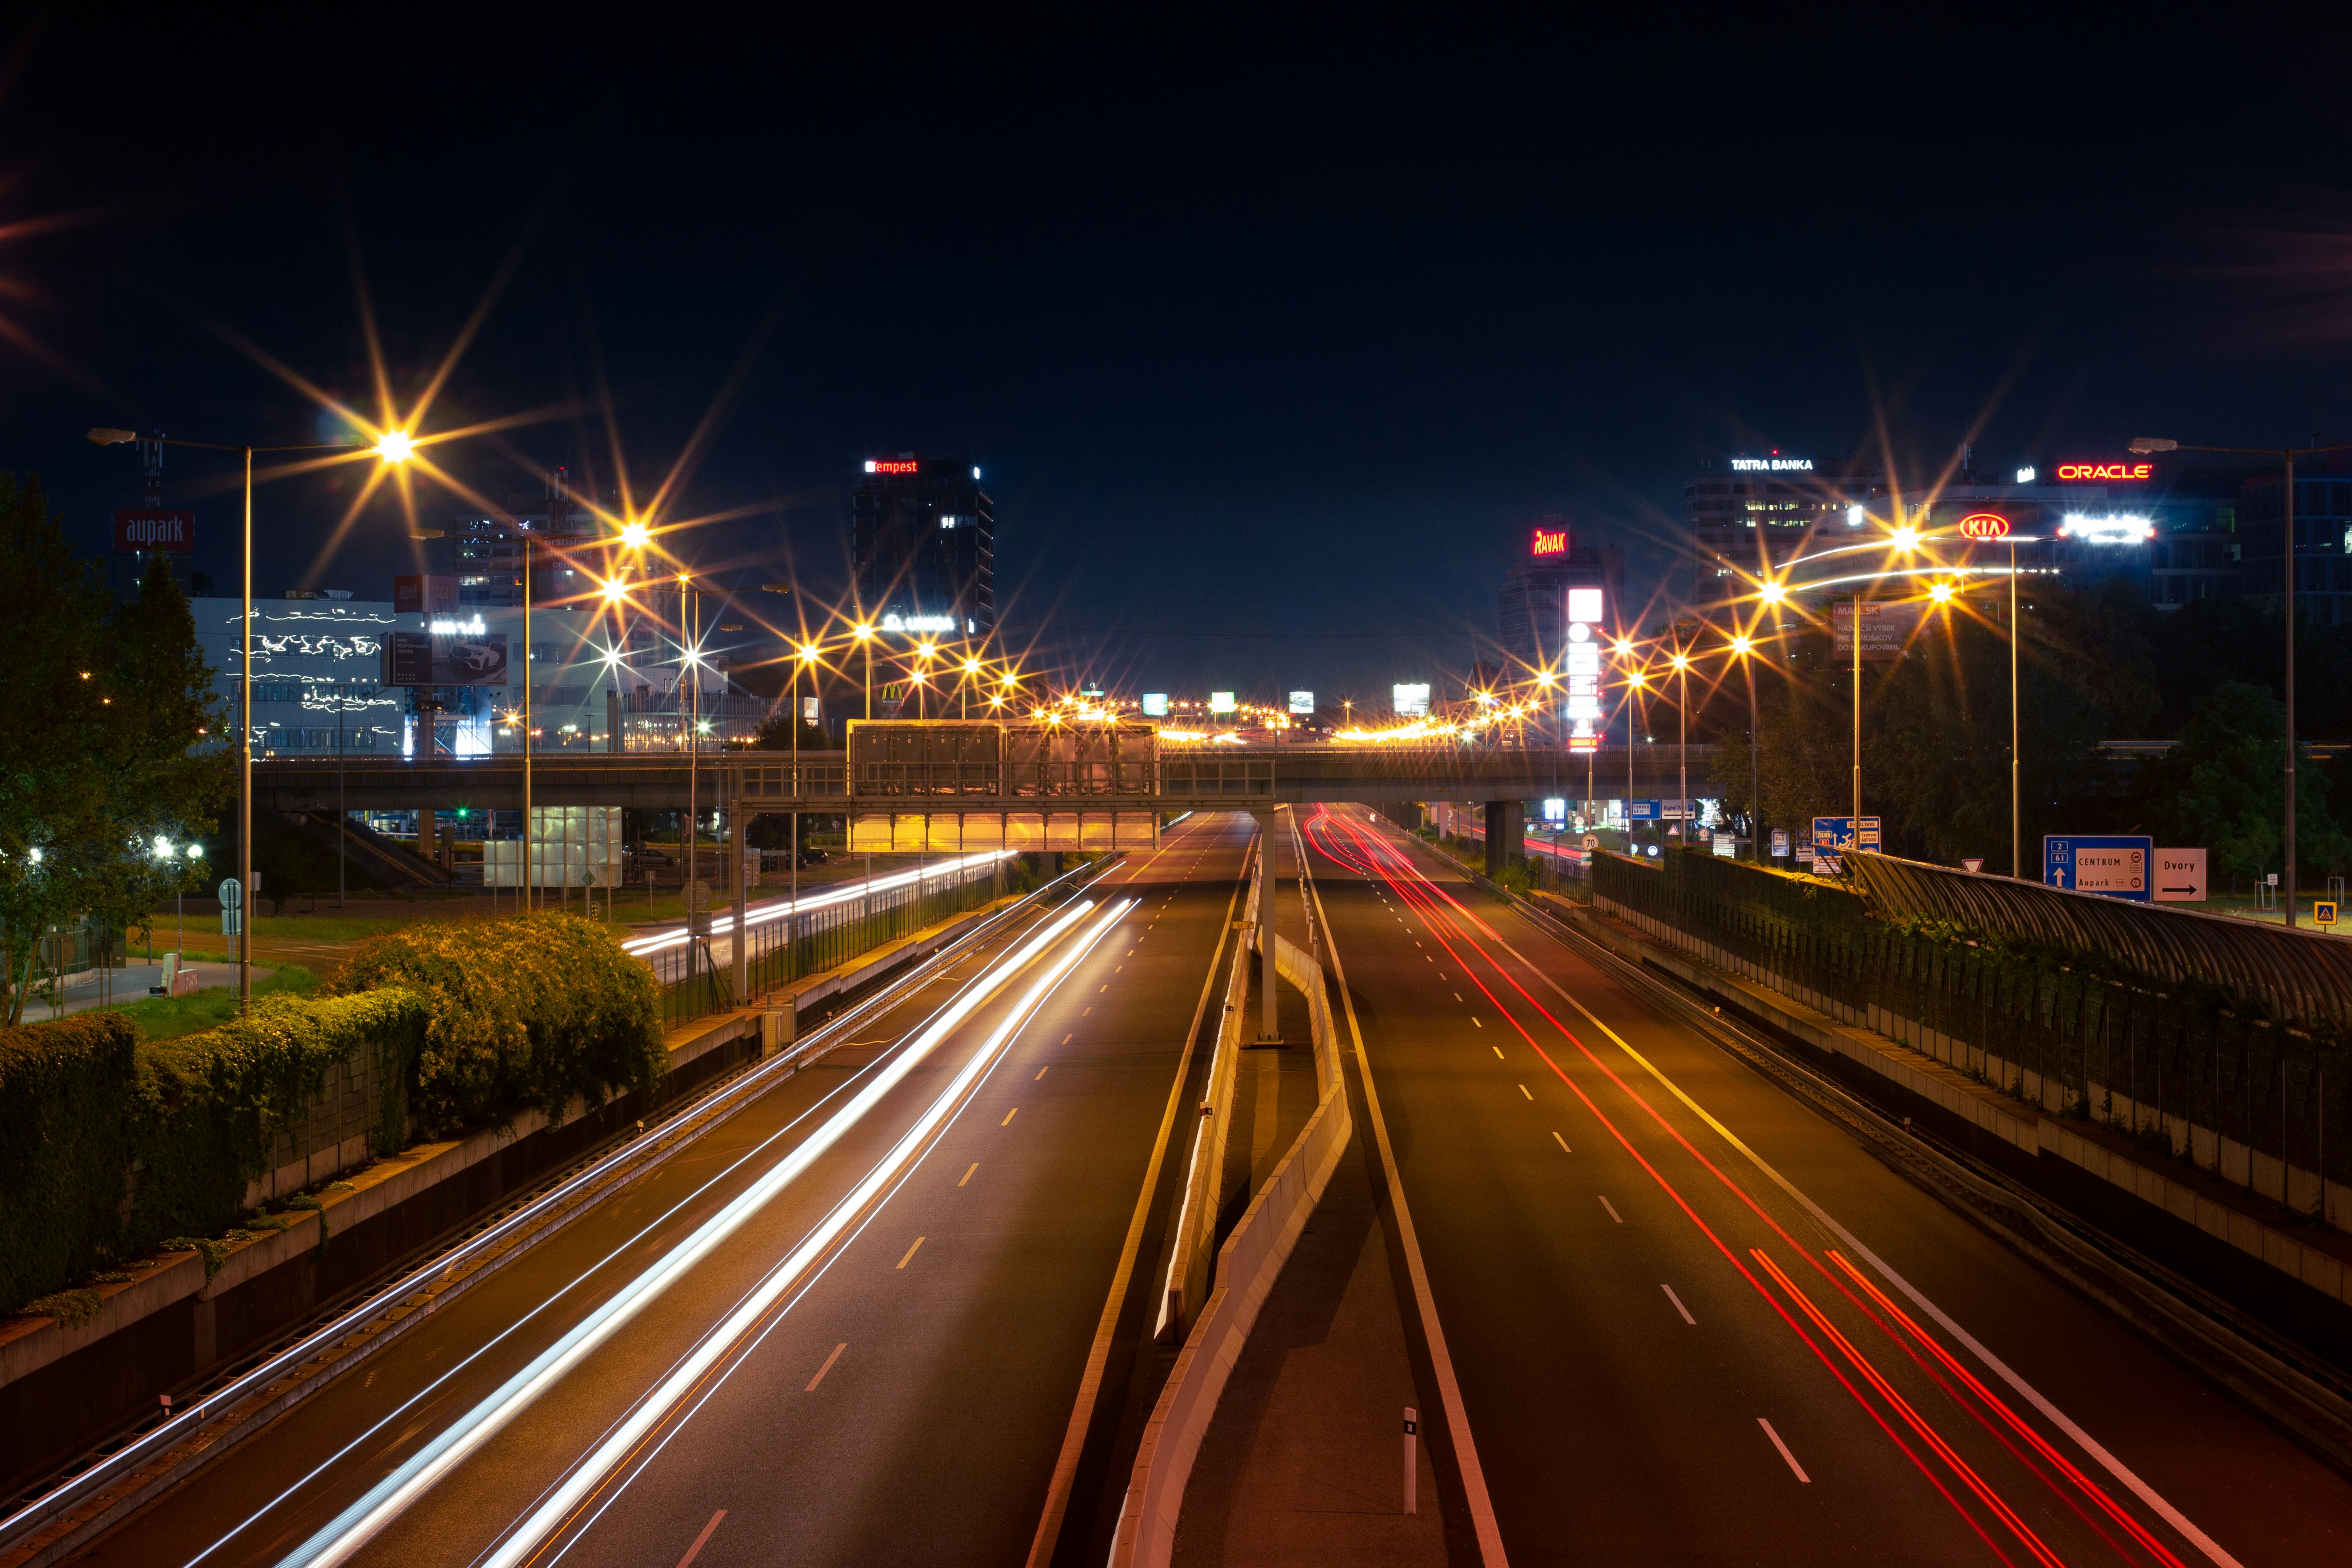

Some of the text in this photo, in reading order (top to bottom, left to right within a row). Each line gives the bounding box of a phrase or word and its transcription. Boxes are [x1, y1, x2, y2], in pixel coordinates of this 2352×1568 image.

[1731, 459, 1813, 470] TATRA BANKA
[2058, 465, 2149, 479] ORACLE
[127, 515, 183, 546] aupark
[1969, 520, 2000, 535] KIA
[1534, 531, 1564, 554] RAVAK
[545, 548, 592, 560] shopping
[1838, 606, 1878, 615] MAL.SK
[1587, 839, 1595, 847] 70
[2165, 861, 2195, 873] Dvory
[2079, 879, 2109, 888] Aupark
